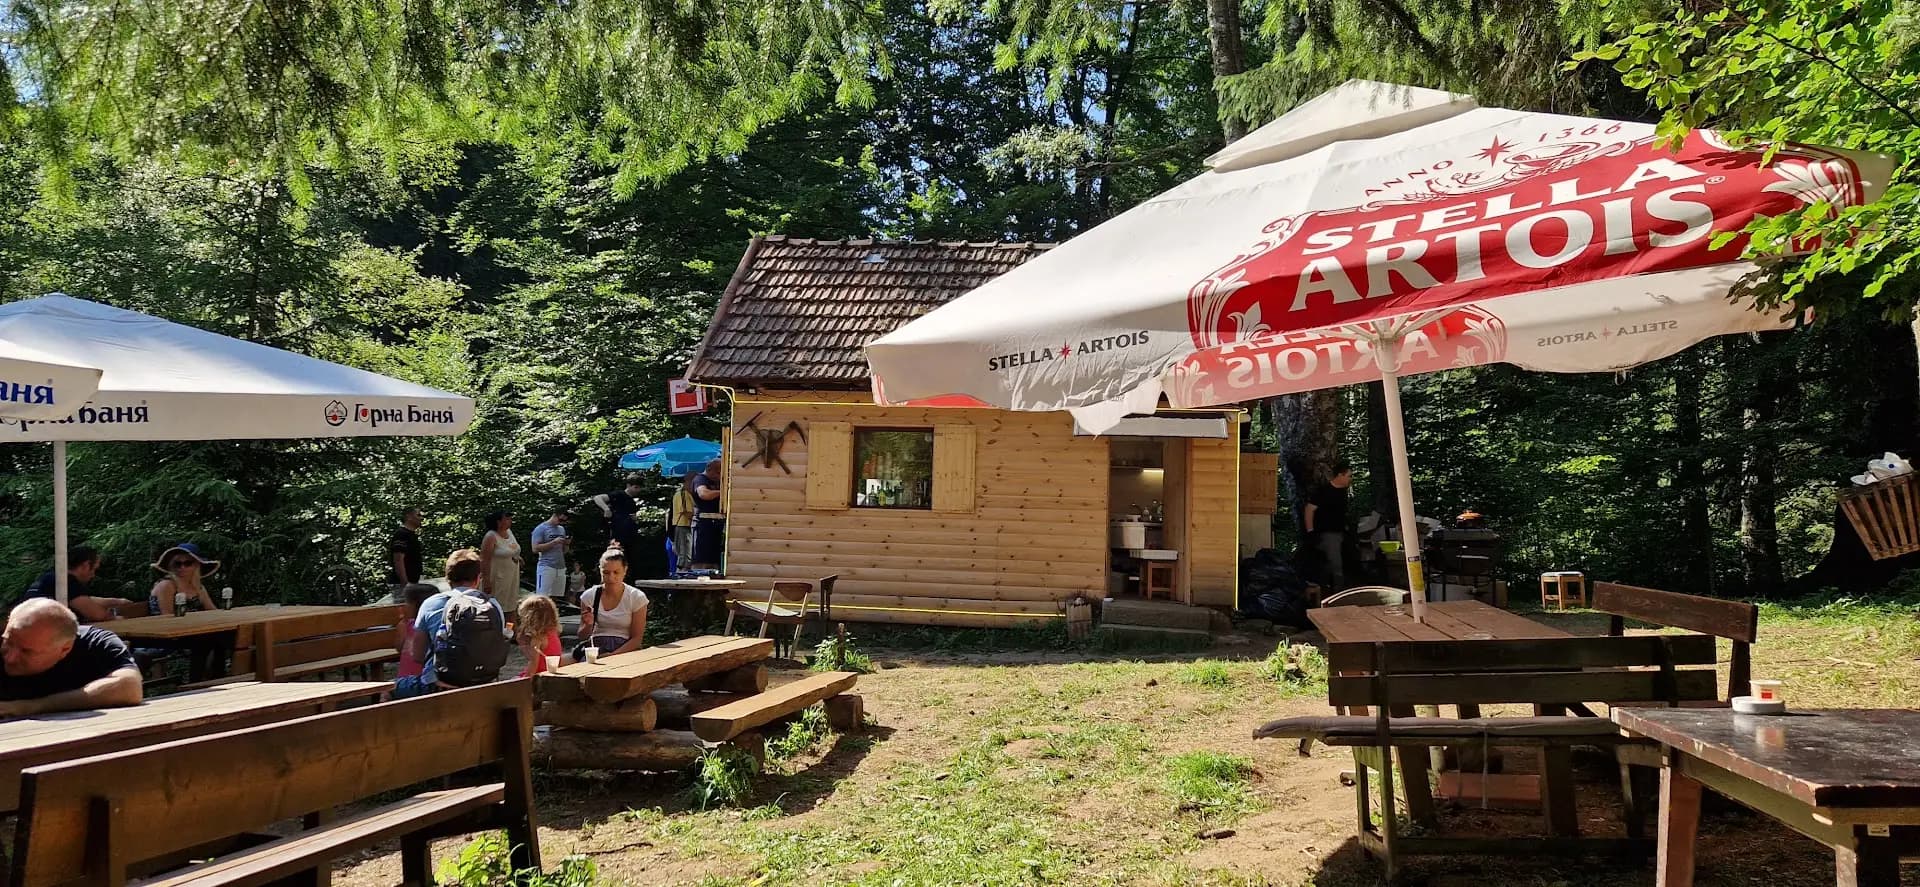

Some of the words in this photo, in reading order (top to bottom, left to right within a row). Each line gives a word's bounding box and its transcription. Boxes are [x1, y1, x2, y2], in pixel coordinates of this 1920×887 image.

[1365, 160, 1453, 197] ANNO
[1538, 123, 1622, 142] 1366
[1302, 158, 1707, 256] STELLA
[1288, 184, 1714, 312] ARTOIS
[988, 348, 1054, 371] STELLA
[1077, 330, 1149, 355] ARTOIS
[354, 403, 403, 428] Горна
[407, 404, 454, 424] Баня
